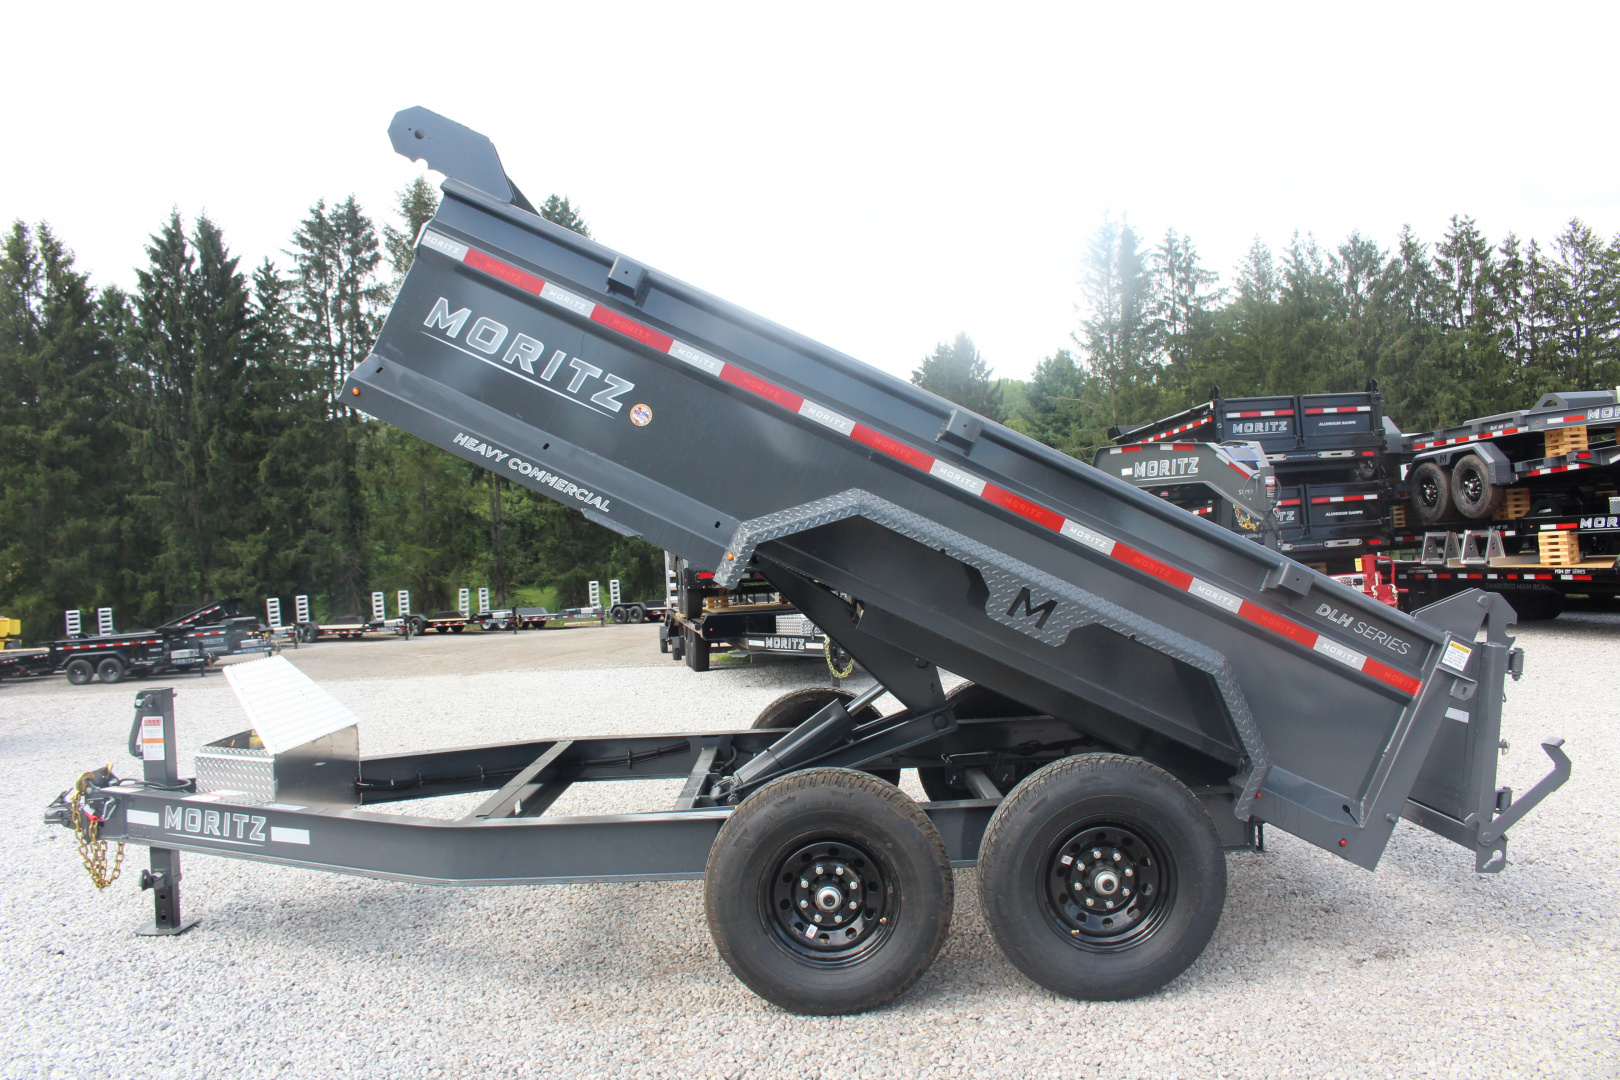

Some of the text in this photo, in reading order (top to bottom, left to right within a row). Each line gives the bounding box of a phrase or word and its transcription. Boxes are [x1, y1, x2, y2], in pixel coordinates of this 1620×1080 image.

[424, 234, 460, 254] MORITZ
[485, 261, 523, 282] MORITZ
[549, 289, 587, 311] MORITZ
[612, 318, 650, 340] MORITZ
[423, 296, 636, 413] MORITZ
[677, 347, 716, 369] MORITZ
[742, 376, 781, 399] MORITZ
[808, 407, 847, 429] MORITZ
[1232, 421, 1288, 433] MORITZ
[874, 437, 912, 459] MORITZ
[453, 433, 610, 512] HEAVY COMMERCIAL
[939, 466, 978, 489] MORITZ
[1134, 457, 1199, 477] MORITZ
[1004, 496, 1042, 518] MORITZ
[1068, 526, 1107, 548] MORITZ
[1133, 556, 1171, 578] MORITZ
[1197, 585, 1235, 607] MORITZ
[1006, 586, 1059, 630] M
[1260, 613, 1298, 636] MORITZ
[1315, 603, 1411, 656] DLH SERIES
[765, 637, 805, 650] MORITZ
[1322, 643, 1359, 664] MORITZ
[164, 805, 267, 842] MORITZ
